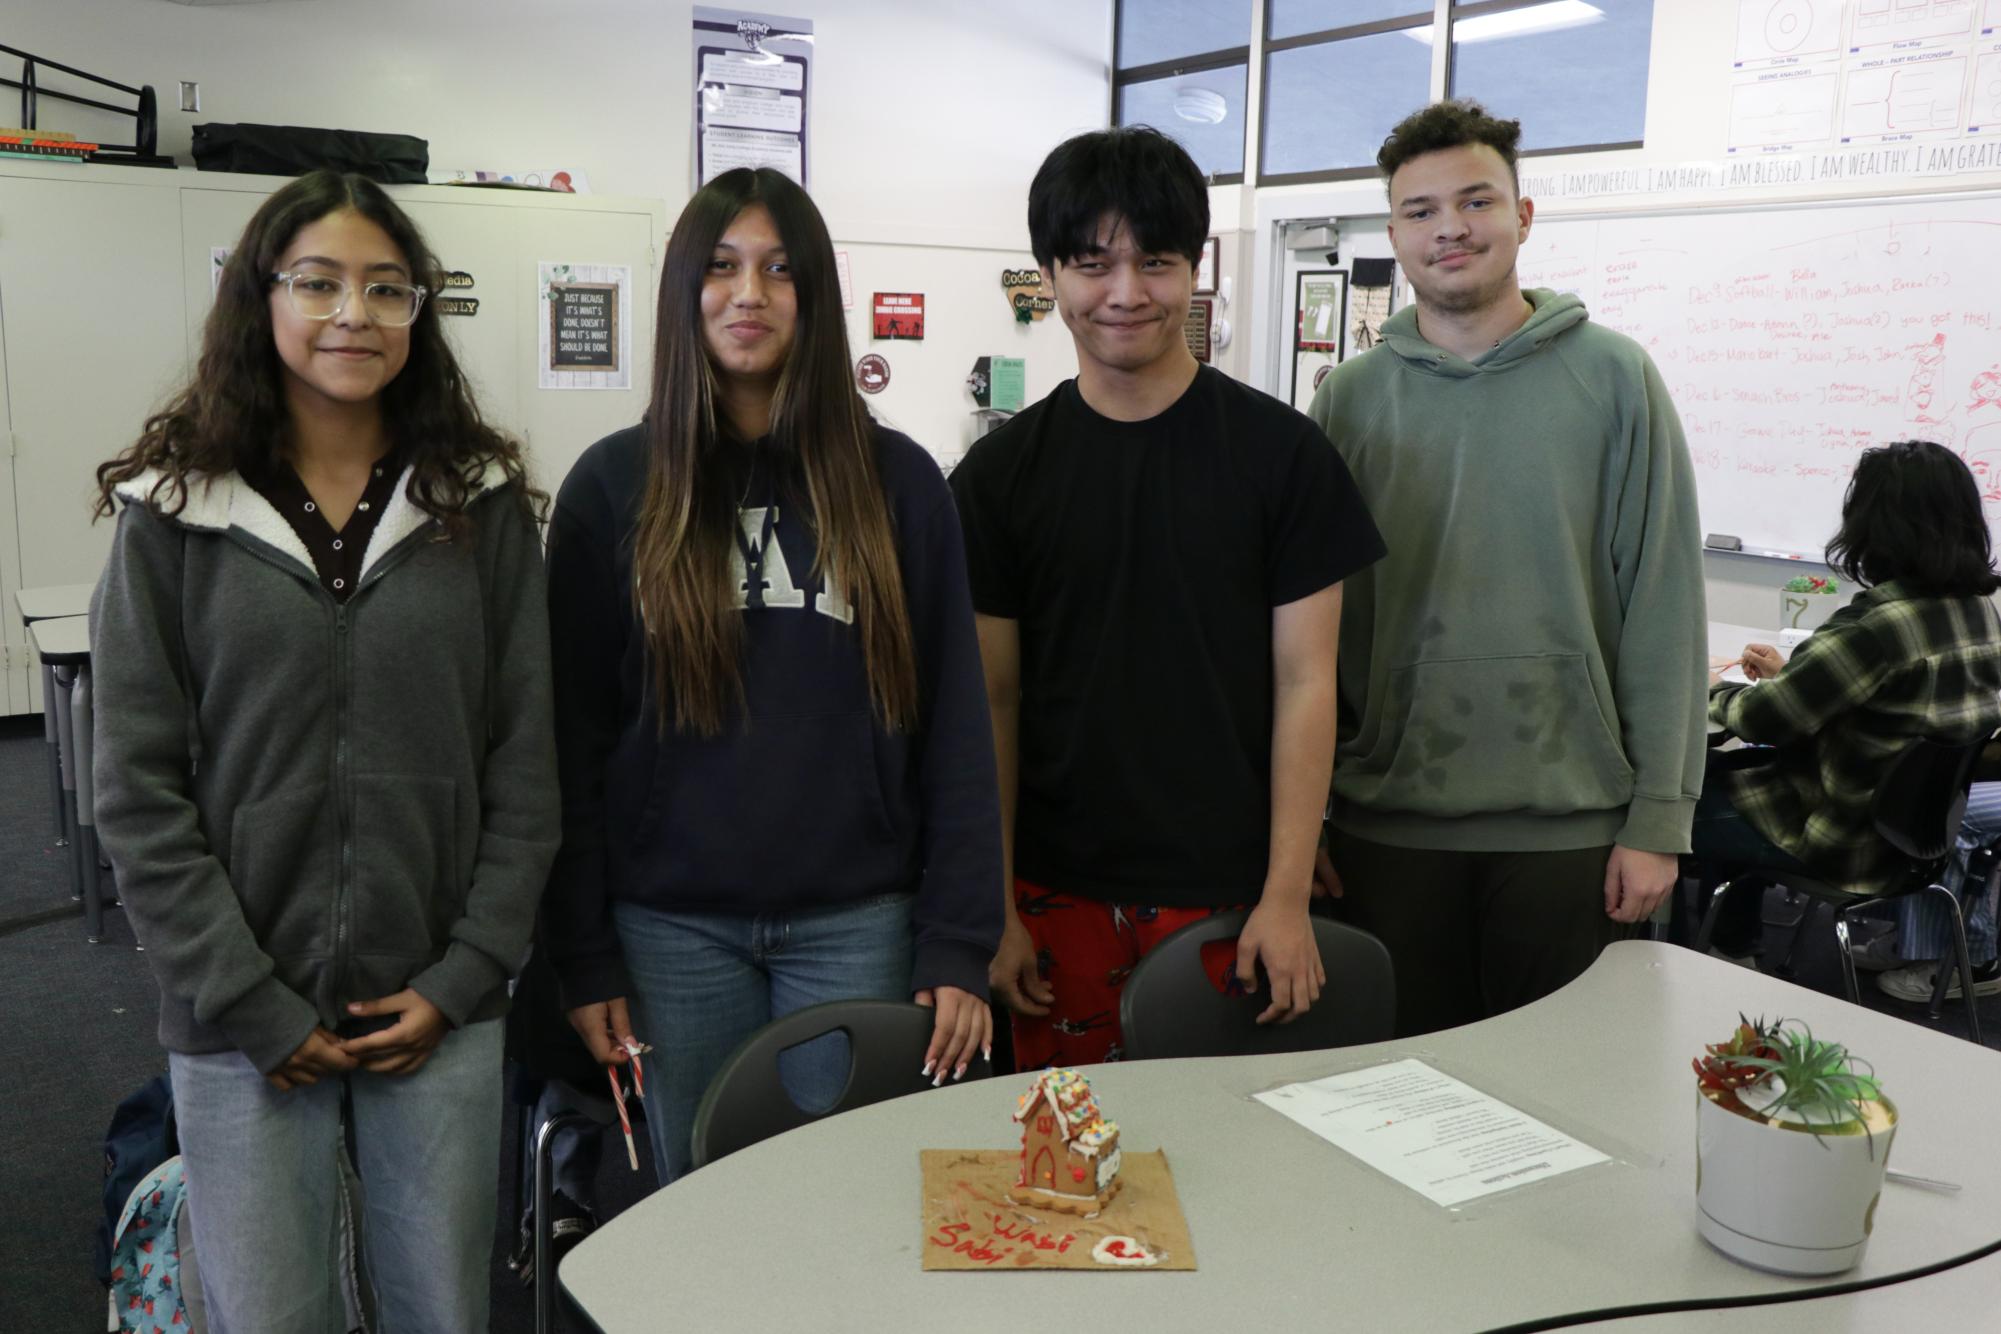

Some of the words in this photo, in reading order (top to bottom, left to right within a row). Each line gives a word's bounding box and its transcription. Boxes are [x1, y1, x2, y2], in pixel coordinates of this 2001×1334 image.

[1861, 60, 1884, 68] WHOLE
[1890, 57, 1905, 65] PART
[1906, 50, 1954, 62] RELATIONSHIP
[1779, 69, 1812, 78] ANALOGIES
[1520, 175, 1556, 198] TRONG
[1569, 171, 1587, 195] AM
[1648, 167, 1653, 192] I
[1657, 167, 1678, 191] AM
[1729, 162, 1751, 186] AM
[1810, 155, 1817, 181] I
[1820, 155, 1844, 179] AM
[1915, 145, 1923, 172] I
[1927, 146, 1955, 171] AM
[441, 275, 473, 286] edia
[1003, 270, 1041, 286] Cocoa
[564, 293, 579, 303] JUST
[580, 293, 605, 304] BECAUSE
[1015, 294, 1054, 309] Corner
[565, 305, 579, 316] IT'S
[579, 306, 603, 316] WHAT'S
[560, 329, 576, 340] MEAN
[577, 330, 590, 340] IT'S
[591, 330, 608, 340] WHAT
[560, 342, 583, 352] SHOULD
[584, 342, 591, 352] BE
